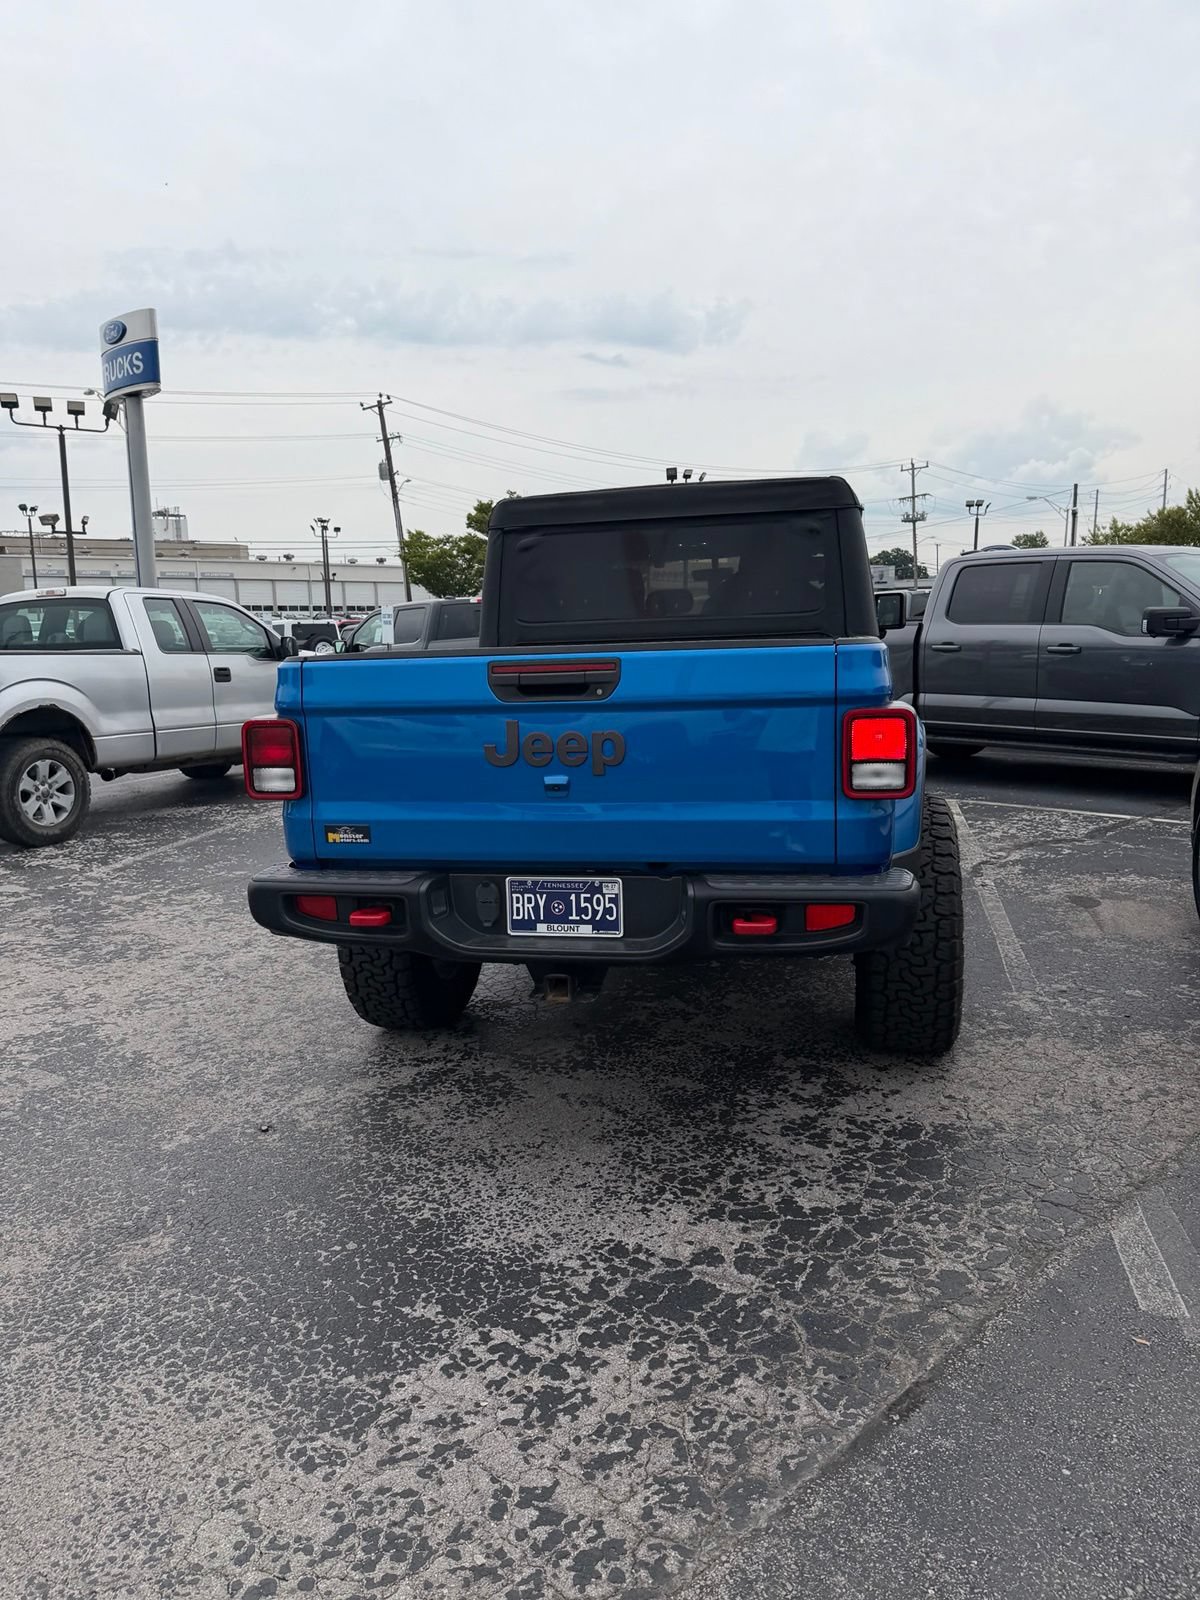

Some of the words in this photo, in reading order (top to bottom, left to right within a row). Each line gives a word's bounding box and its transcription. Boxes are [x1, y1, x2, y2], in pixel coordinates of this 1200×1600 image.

[483, 719, 626, 776] Jeep
[511, 893, 547, 920] BRY
[568, 893, 617, 921] 1595
[546, 924, 581, 933] BLOUNT
